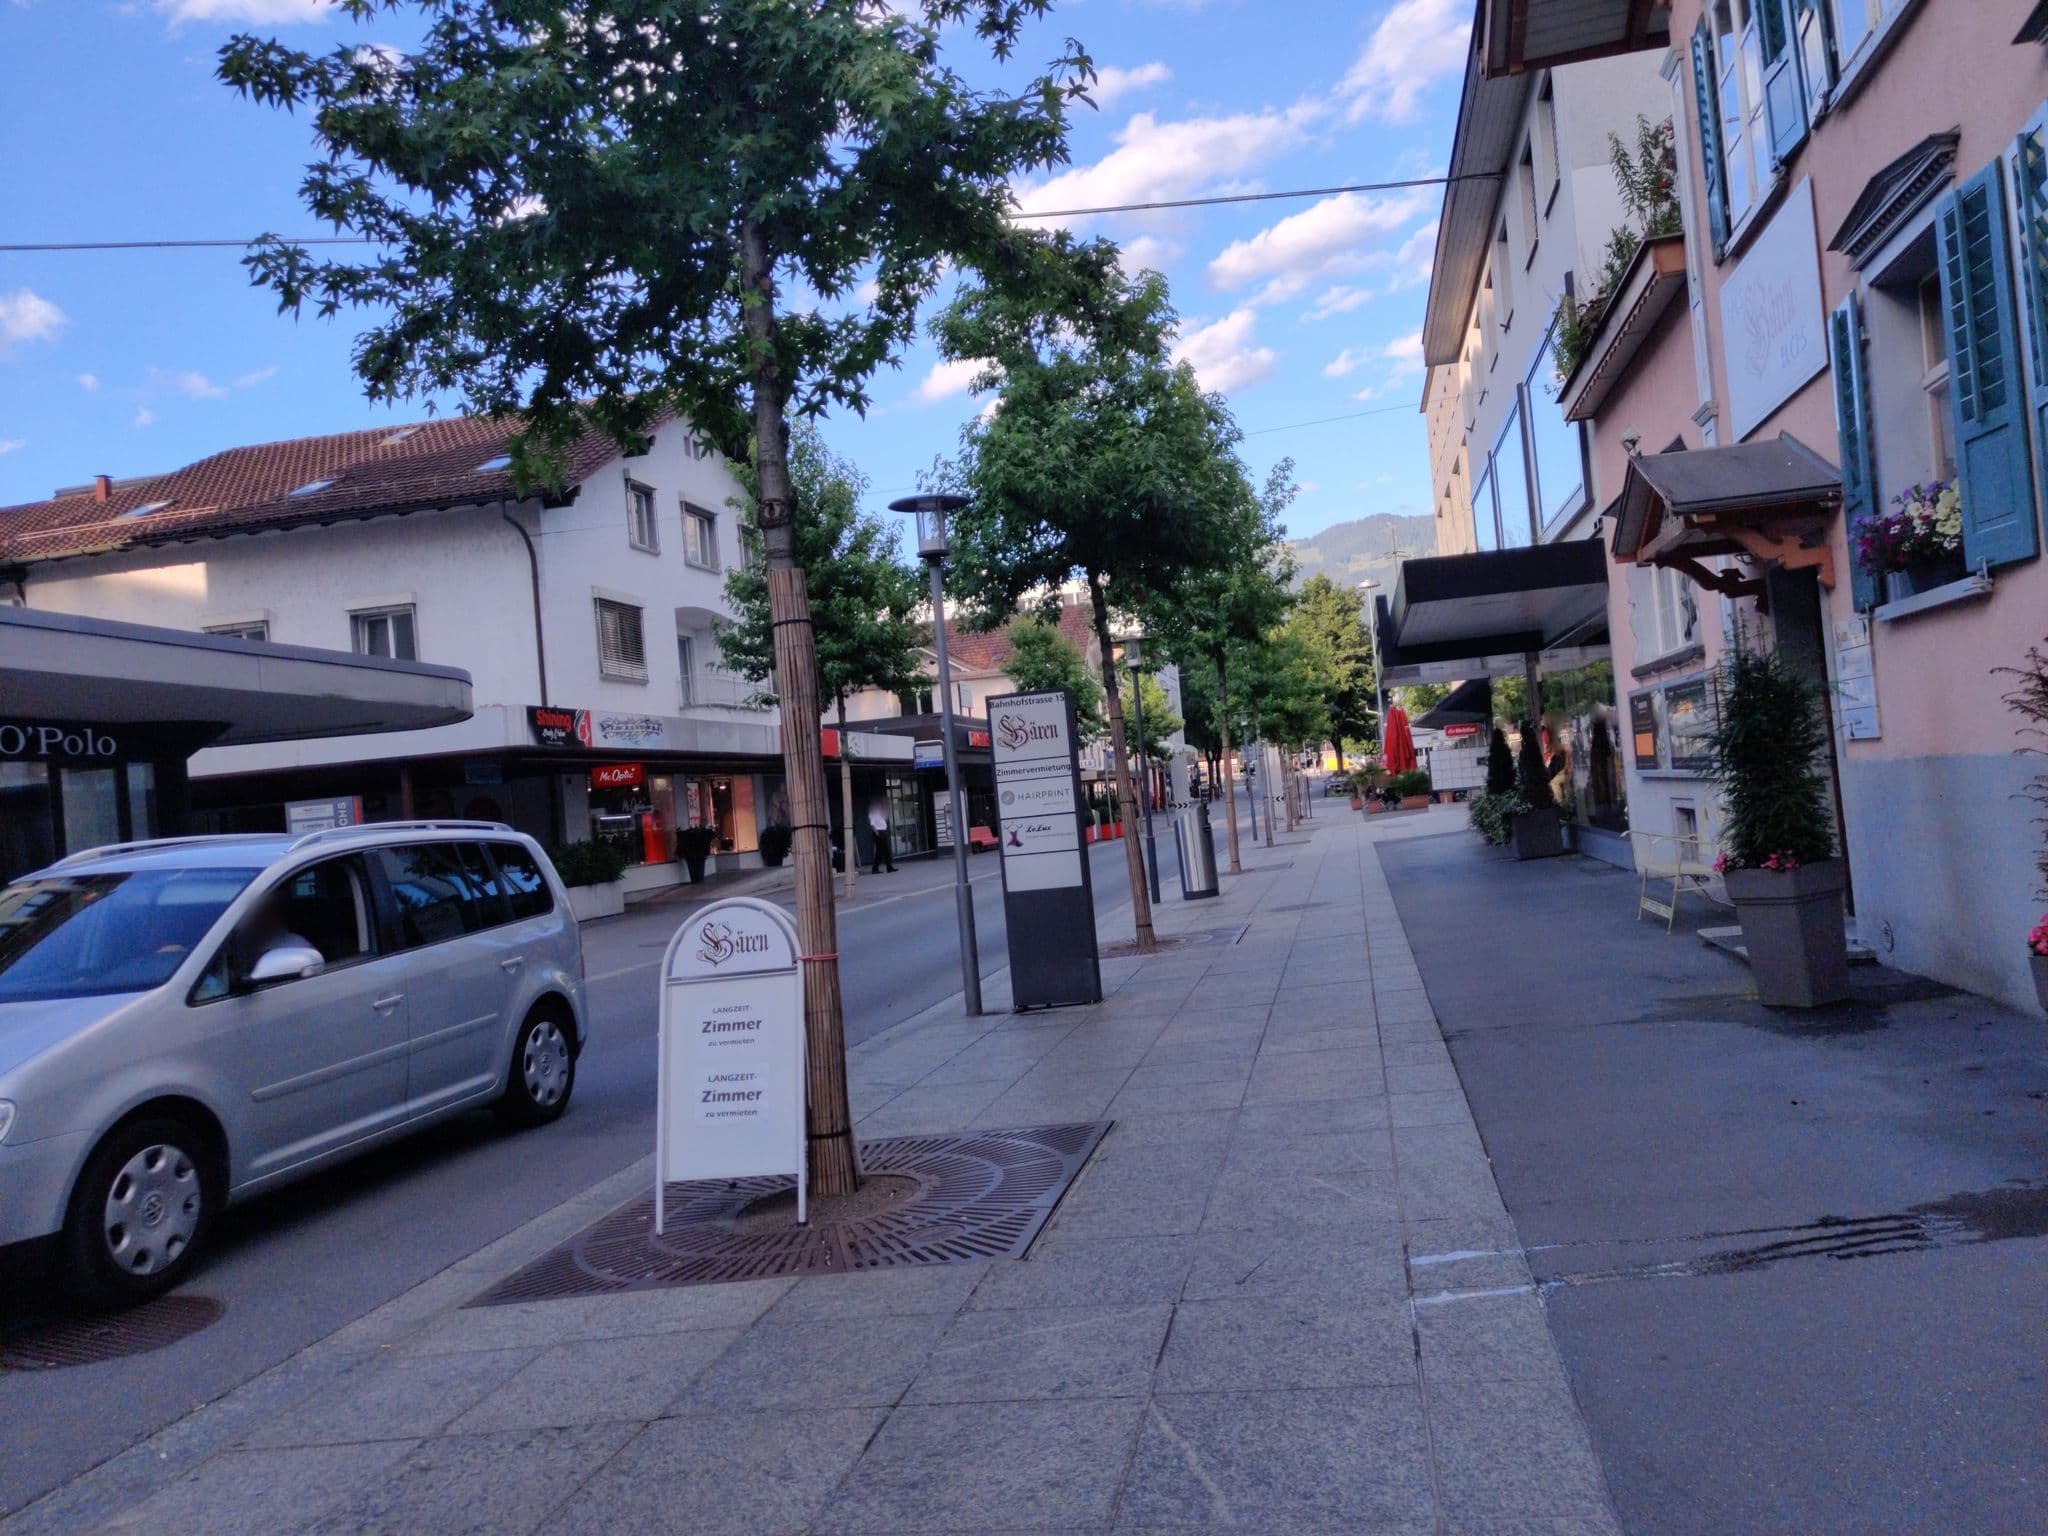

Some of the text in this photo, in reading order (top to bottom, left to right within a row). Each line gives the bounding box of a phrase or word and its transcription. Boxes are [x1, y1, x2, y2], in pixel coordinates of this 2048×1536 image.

[990, 693, 1065, 709] Bahnhofstrasse 15
[536, 709, 572, 734] Shining
[0, 725, 117, 755] O'Polo
[997, 715, 1059, 752] Bären
[996, 763, 1072, 777] Zimmervermietung
[1018, 788, 1071, 801] HAIRPRINT
[697, 922, 769, 968] Bären
[701, 1020, 762, 1033] Zimmer
[701, 1090, 762, 1103] Zimmer
[717, 1109, 758, 1118] vermieten
